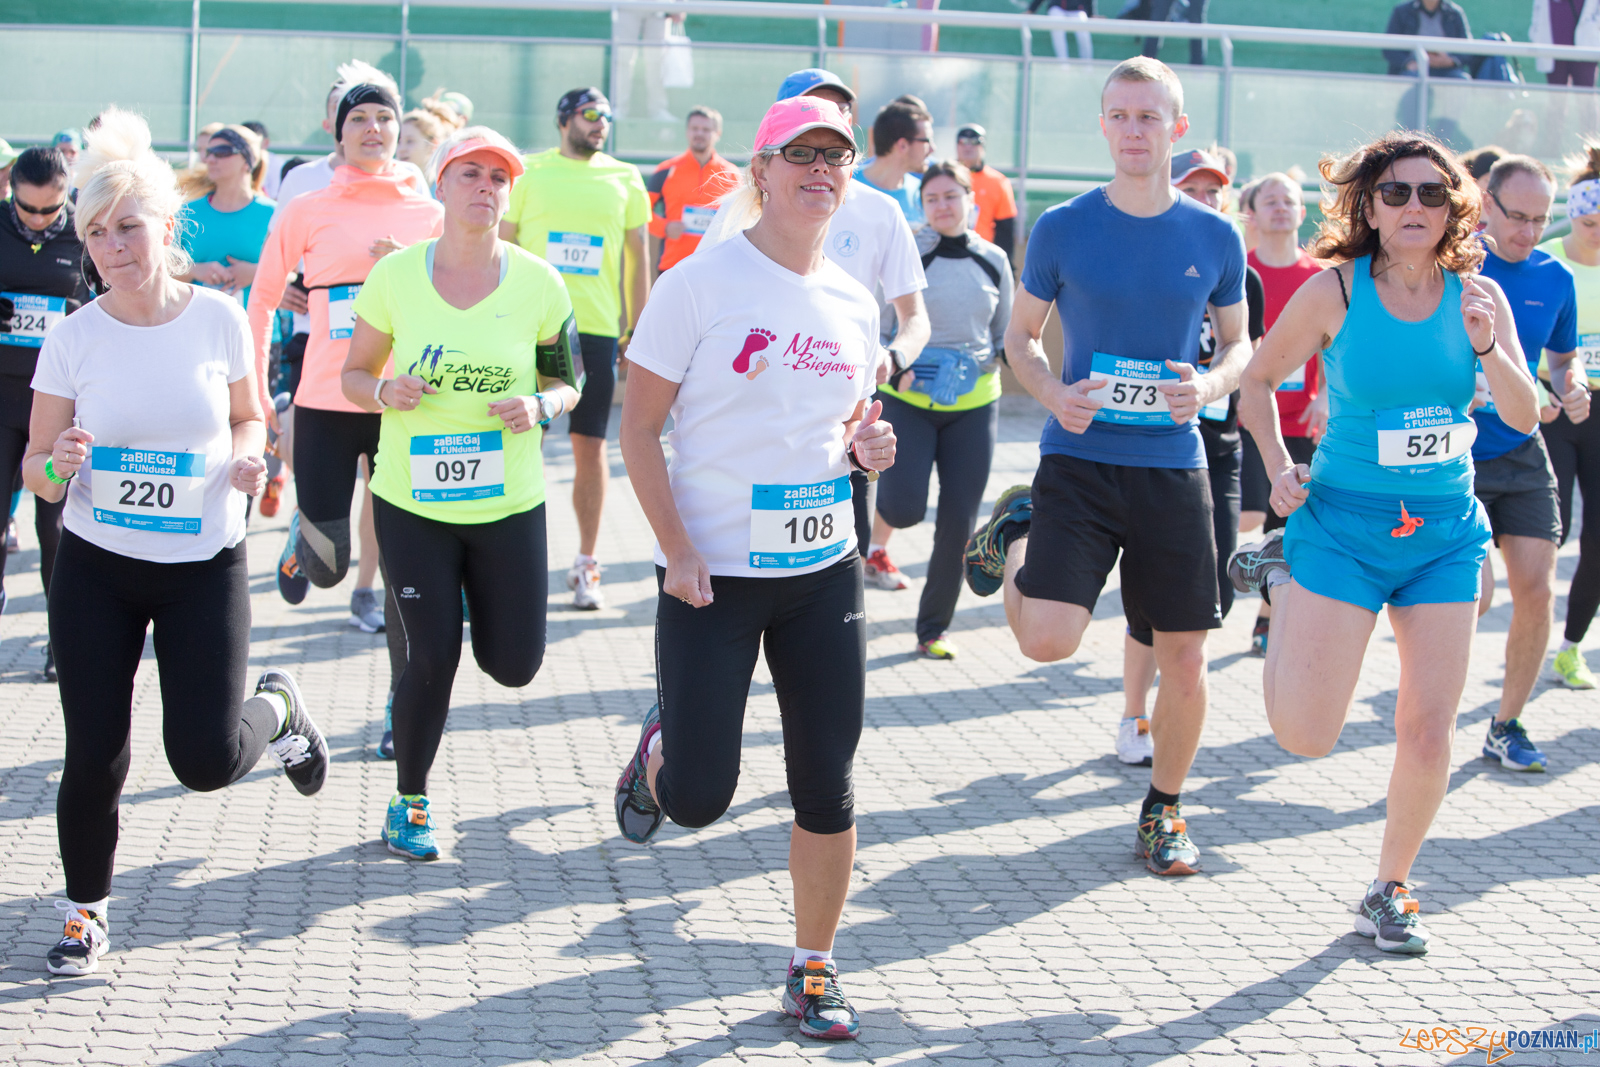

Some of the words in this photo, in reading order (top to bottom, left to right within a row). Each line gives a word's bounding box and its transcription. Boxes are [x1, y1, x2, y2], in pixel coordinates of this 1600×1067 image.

[563, 247, 589, 262] 107
[12, 313, 46, 332] 324
[783, 332, 842, 357] Mamy
[444, 363, 513, 378] ZAWSZE
[1115, 359, 1162, 374] zaBIEGaj
[1121, 368, 1161, 379] FUNdusze
[453, 376, 517, 393] BIEGU
[1112, 382, 1157, 406] 573
[1403, 405, 1453, 421] zaBIEGaj
[1412, 417, 1454, 428] FUNdusze
[433, 434, 481, 447] zaBIEGaj
[1406, 431, 1451, 458] 521
[440, 445, 481, 454] FUNdusze
[120, 451, 177, 468] zaBIEGaj
[128, 463, 176, 475] FUNdusze
[435, 458, 482, 482] 097
[118, 479, 175, 509] 220
[783, 482, 835, 499] zaBIEGaj
[783, 501, 791, 509] o
[792, 496, 835, 509] FUNdusze
[784, 512, 834, 544] 108
